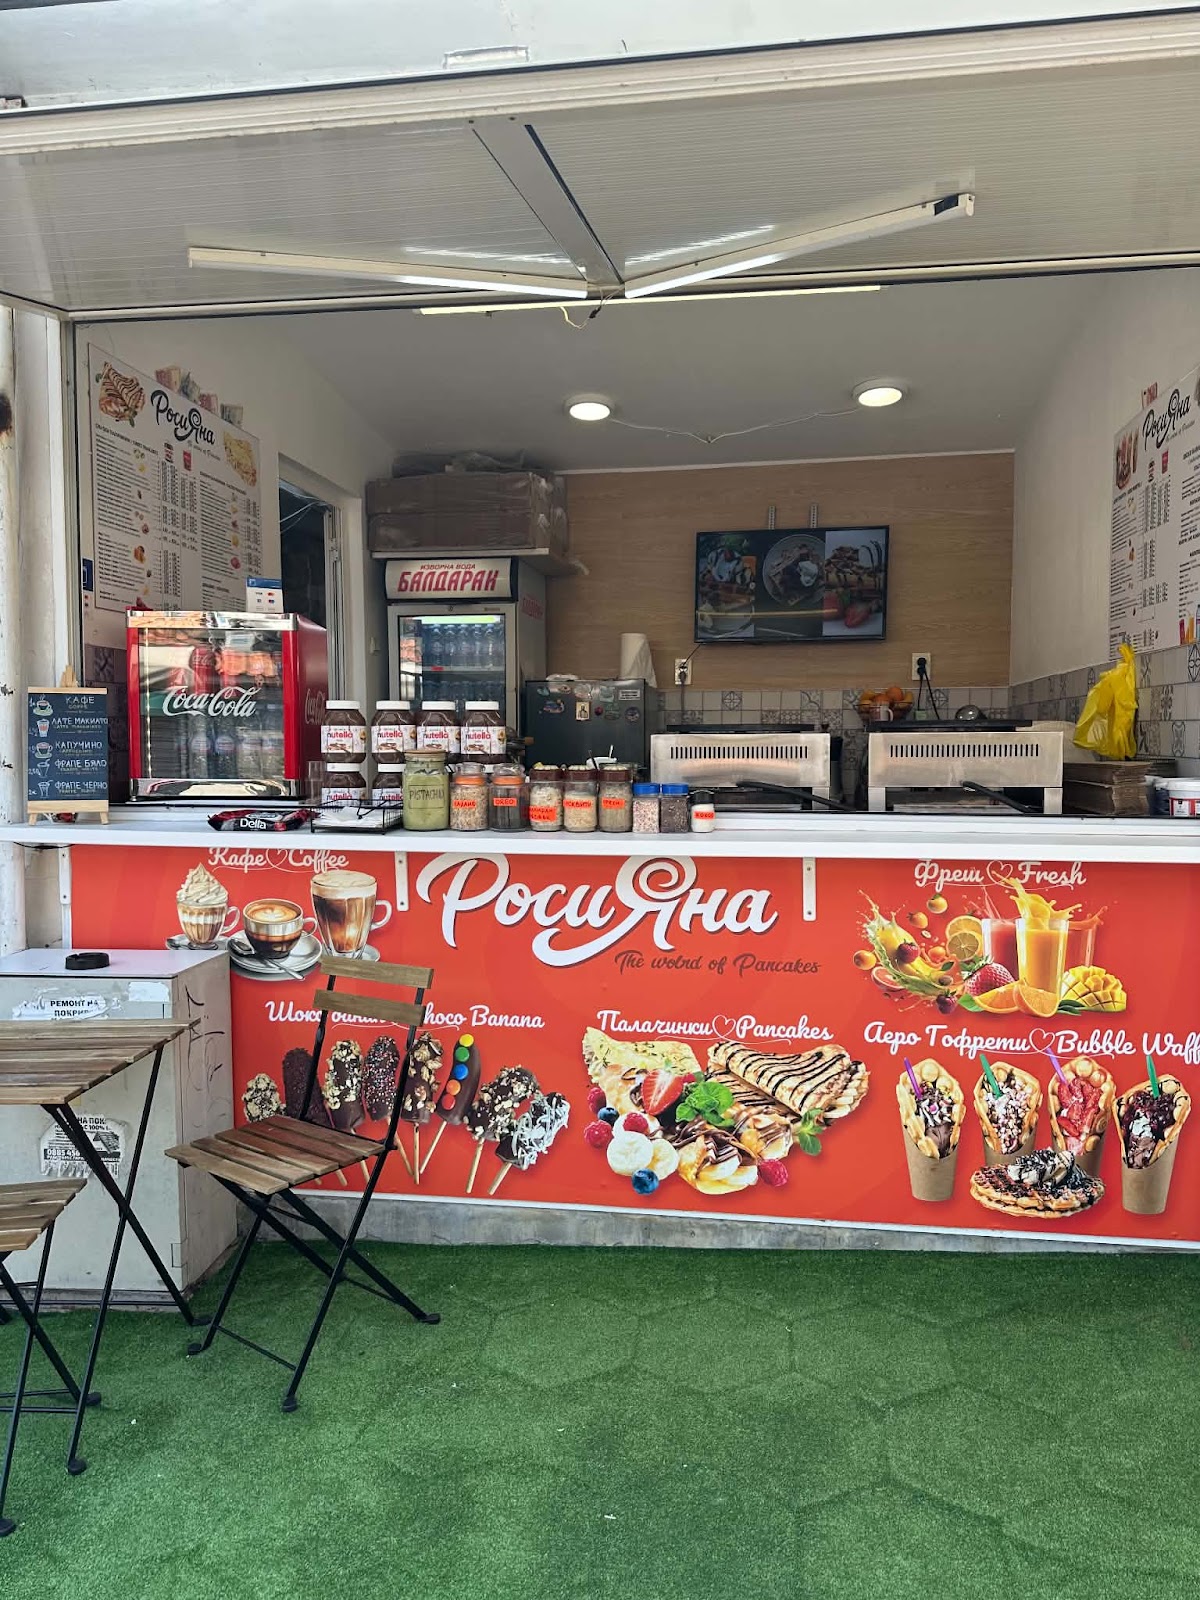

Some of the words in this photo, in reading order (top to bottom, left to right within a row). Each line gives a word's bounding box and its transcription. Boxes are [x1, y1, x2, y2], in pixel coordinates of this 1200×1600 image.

[420, 563, 454, 571] ИЗВОРНА
[397, 570, 500, 592] БАЛДАРАН
[65, 695, 95, 705] КАФЕ
[163, 686, 261, 717] Coca-Cola
[51, 717, 72, 725] ЛАТЕ
[74, 717, 108, 725] МАКИАТО
[55, 741, 103, 749] КАПУЧИНО
[326, 730, 353, 739] nutella
[377, 730, 404, 739] nutella
[423, 731, 449, 740] nutella
[465, 732, 491, 740] nutella
[54, 759, 82, 769] ФРАПЕ
[85, 759, 107, 768] БЯЛО
[54, 781, 82, 790] ФРАПЕ
[83, 781, 108, 790] ЧЕРНО
[208, 847, 267, 874] Кафе
[288, 848, 350, 874] Coffee
[914, 858, 984, 893] Фреш
[1018, 861, 1087, 885] Fresh
[415, 852, 779, 968] РосиЯна
[614, 950, 645, 975] The
[708, 956, 728, 975] of
[732, 953, 822, 978] Pancakes
[423, 1002, 467, 1026] hoco
[470, 1004, 546, 1029] Banana
[597, 1010, 714, 1034] Палачинки
[736, 1014, 834, 1041] Pancakes
[864, 1021, 922, 1055] Аеро
[925, 1025, 1031, 1060] Тофрети
[1055, 1029, 1136, 1056] Bubble
[89, 1117, 106, 1125] ПОК
